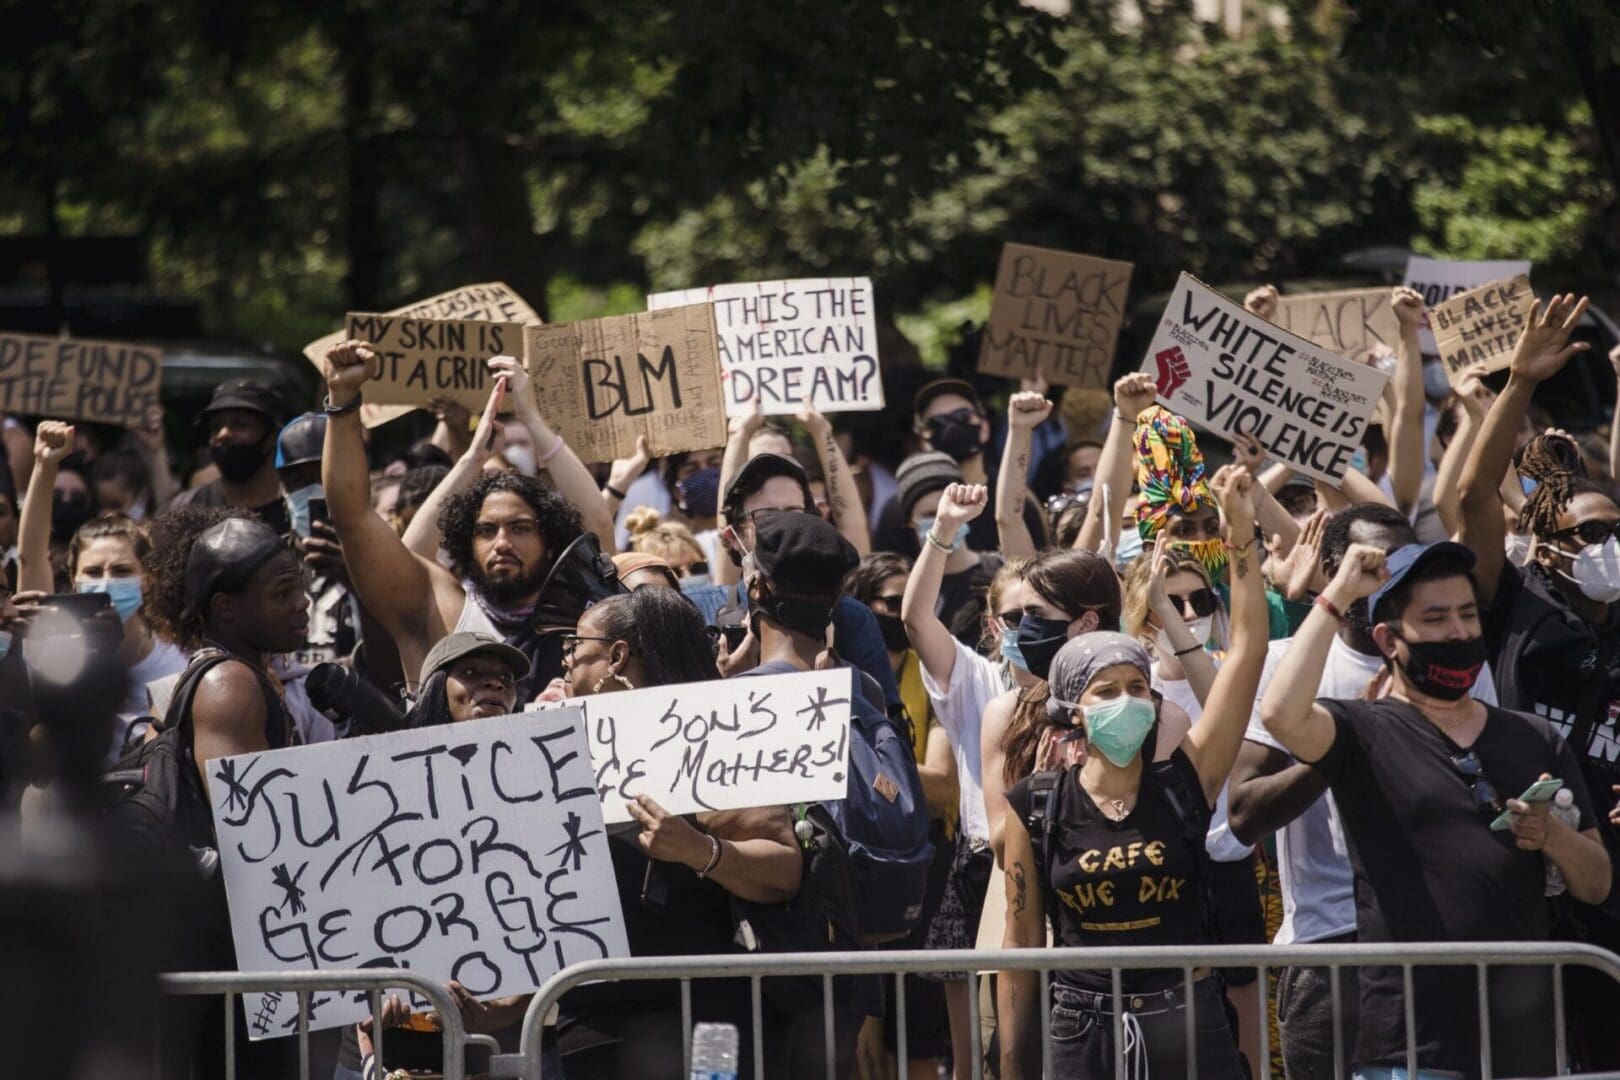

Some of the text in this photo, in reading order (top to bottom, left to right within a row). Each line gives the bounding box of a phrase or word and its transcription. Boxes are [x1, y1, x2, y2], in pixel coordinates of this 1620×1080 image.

[715, 288, 866, 328] THIS THE
[1008, 254, 1127, 315] BLACK
[1436, 283, 1520, 331] BLACK
[350, 317, 504, 354] MY SKIN IS
[717, 325, 864, 363] AMERICAN
[1020, 300, 1111, 347] LIVES
[1183, 290, 1297, 378] WHITE
[1458, 305, 1523, 341] LIVES
[983, 325, 1109, 386] MATTER
[1447, 325, 1524, 373] MATTE
[0, 372, 67, 415] THE
[406, 359, 429, 390] A
[582, 345, 682, 420] BLM
[731, 355, 877, 405] DREAM?
[1211, 353, 1365, 439] SILENCE IS
[1205, 380, 1355, 479] VIOLENCE
[650, 691, 777, 752] SON'S
[320, 815, 543, 892] FOR
[1078, 840, 1167, 873] CAFE
[259, 868, 611, 970] GEORGE
[1056, 875, 1187, 915] RUE DIX
